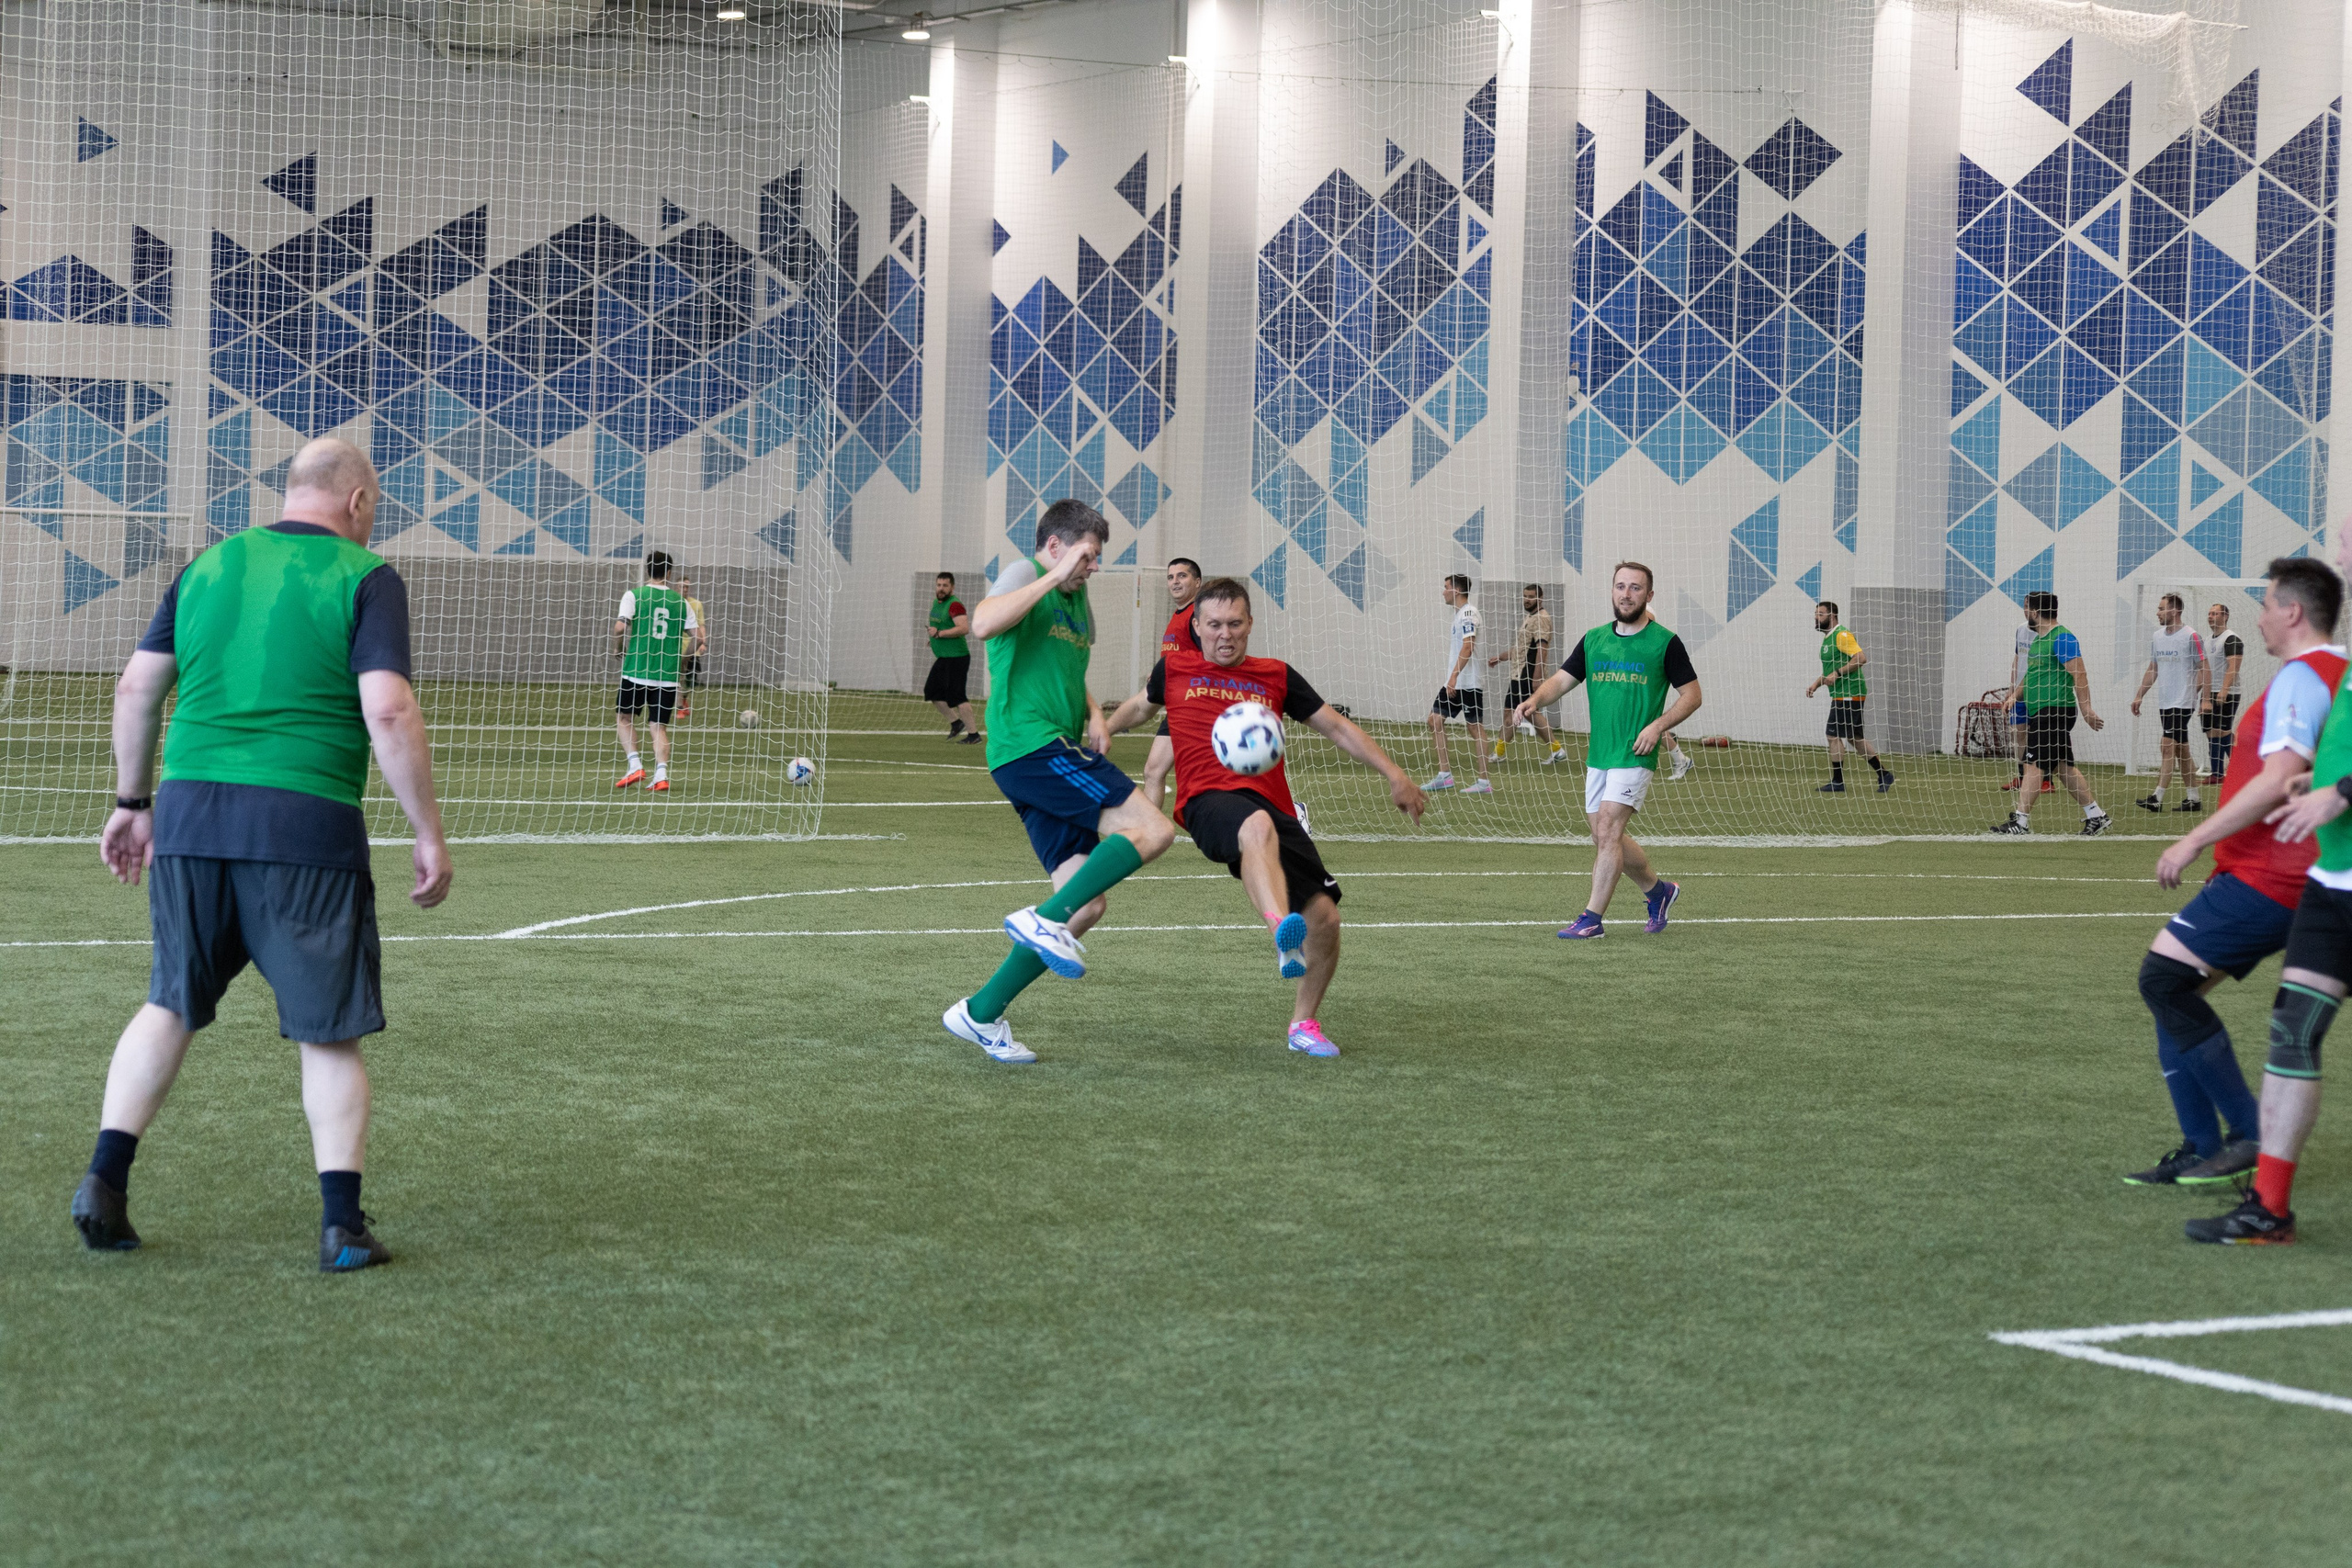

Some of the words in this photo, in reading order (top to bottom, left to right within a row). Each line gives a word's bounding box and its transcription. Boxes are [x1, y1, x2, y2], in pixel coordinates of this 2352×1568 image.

[652, 606, 670, 640] 6
[1594, 660, 1645, 673] DYNAMO
[1190, 676, 1266, 695] DYNAMO
[1591, 671, 1648, 685] ARENA.RU
